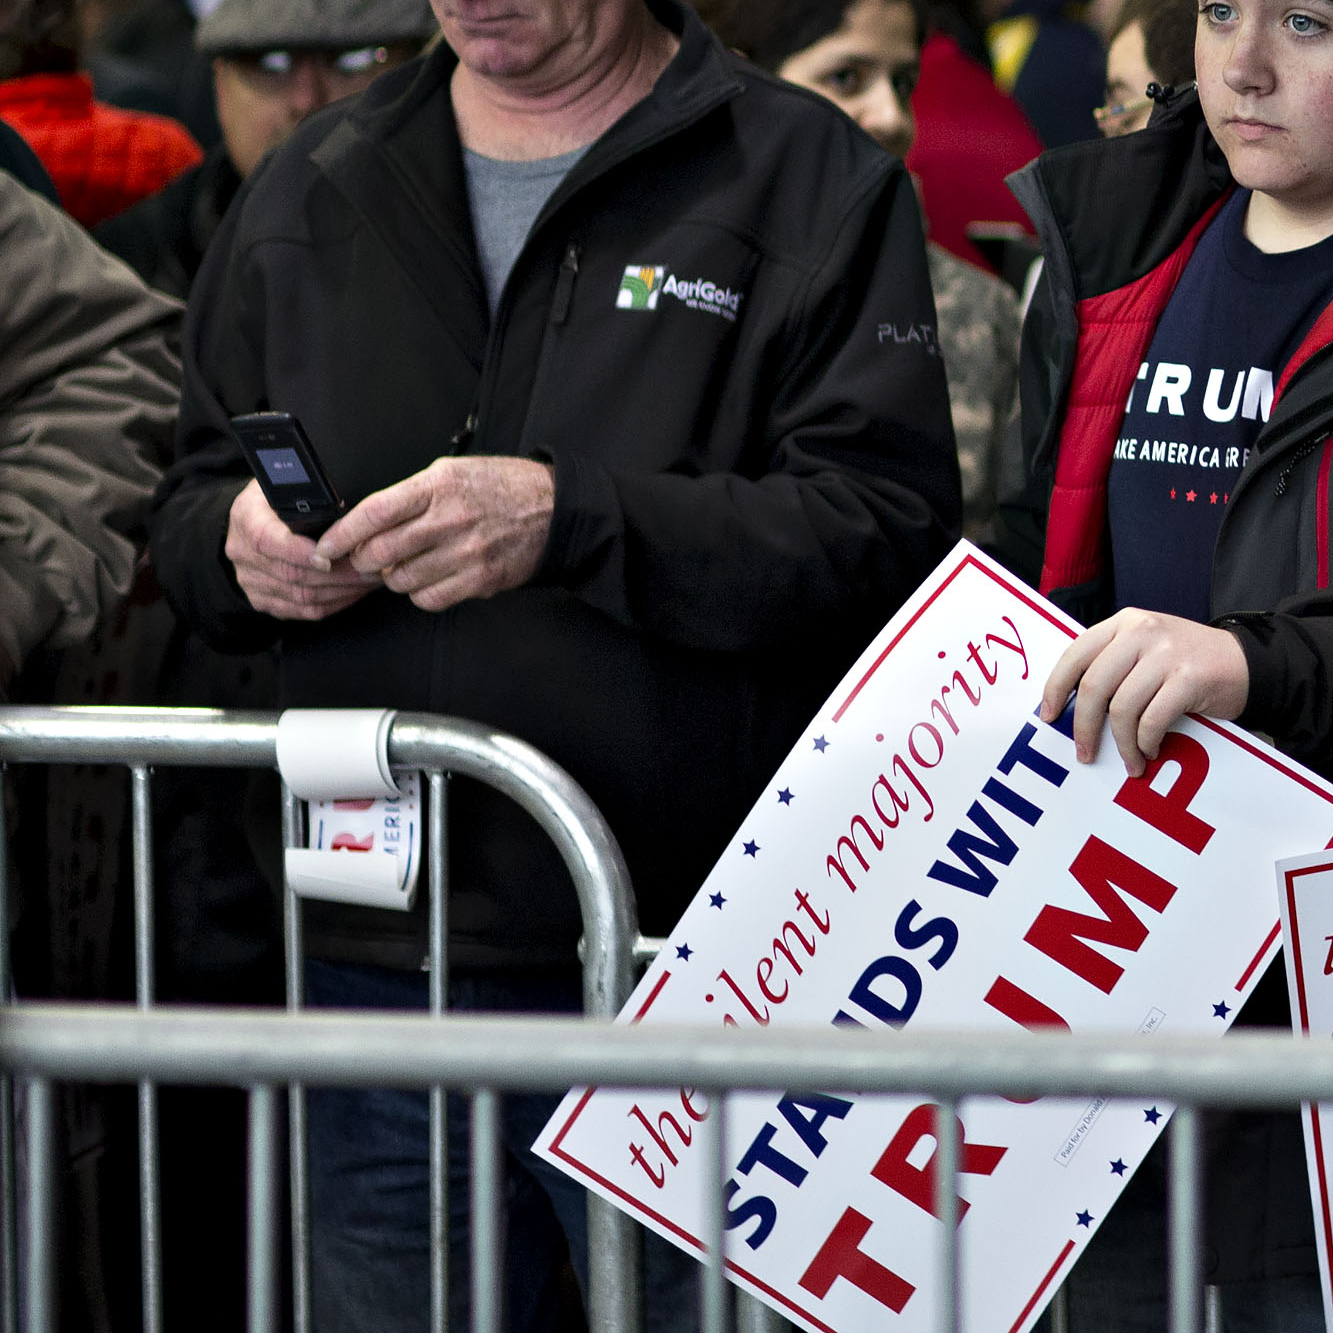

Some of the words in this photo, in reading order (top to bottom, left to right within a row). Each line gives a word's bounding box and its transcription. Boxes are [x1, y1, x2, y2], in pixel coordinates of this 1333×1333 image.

[663, 274, 739, 311] AgriGold
[1113, 438, 1138, 460] AKE
[1139, 439, 1220, 468] AMERICA
[705, 888, 830, 1029] ilent
[826, 615, 1030, 893] majority
